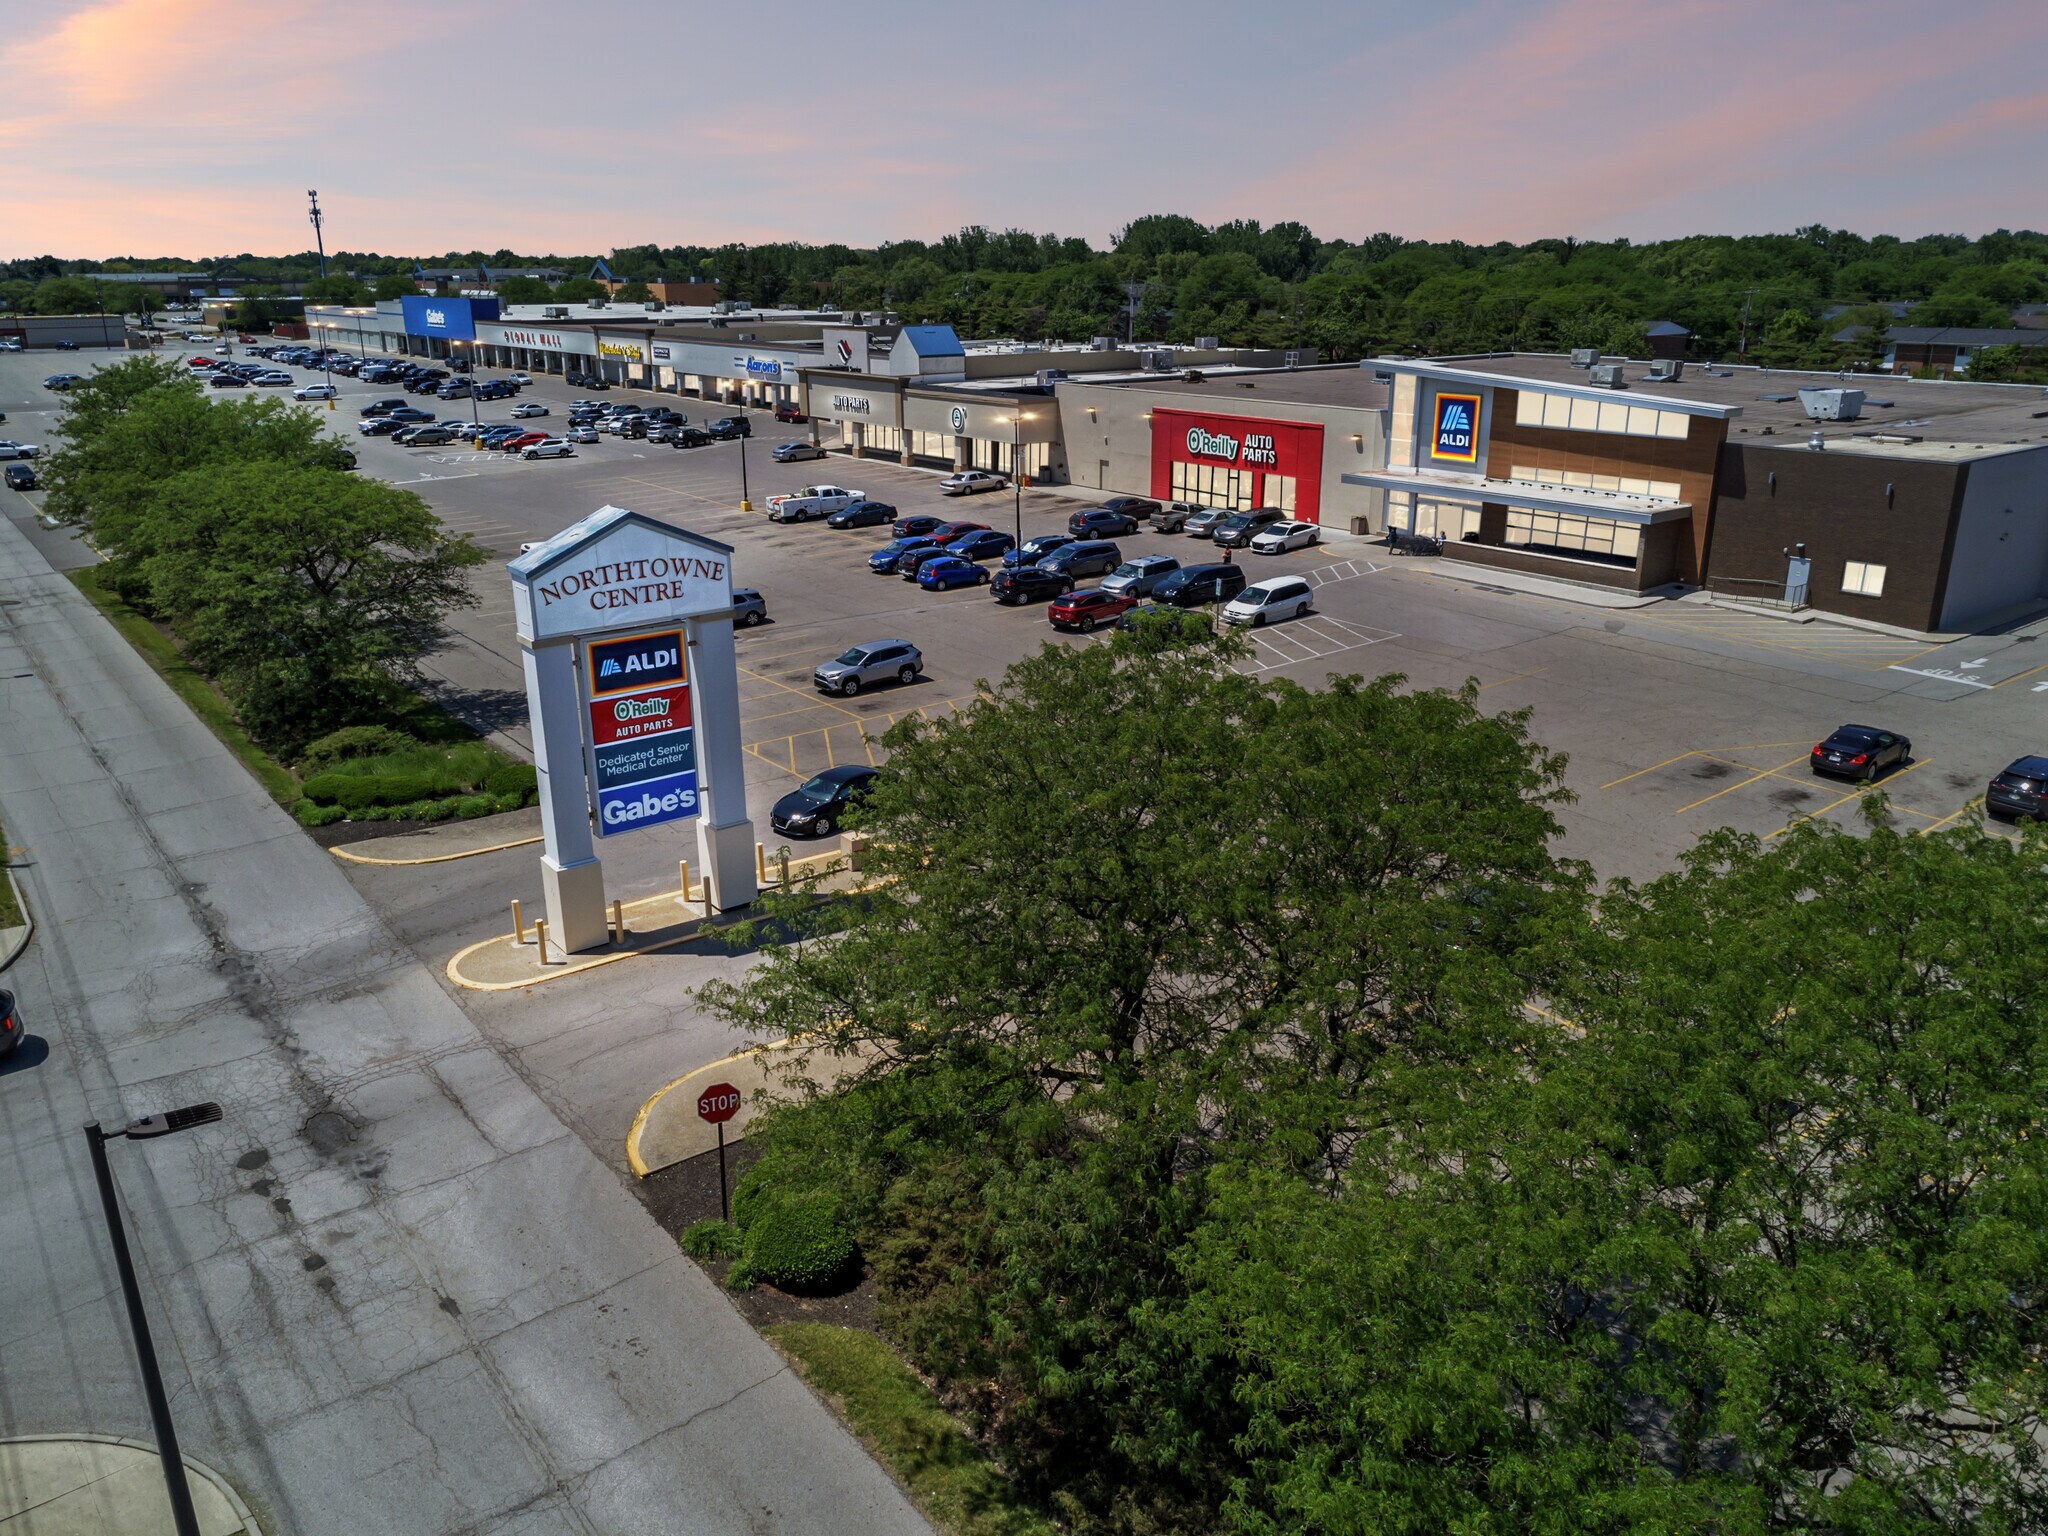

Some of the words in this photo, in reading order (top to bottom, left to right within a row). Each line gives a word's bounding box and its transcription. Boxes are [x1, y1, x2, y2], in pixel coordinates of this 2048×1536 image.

[504, 330, 536, 345] GLOBAL
[540, 333, 562, 348] MALL
[746, 355, 779, 374] Aaron's
[833, 395, 848, 407] AUTO
[849, 397, 868, 410] PARTS
[1187, 427, 1238, 460] O'Reilly
[1244, 433, 1273, 449] AUTO
[1439, 433, 1470, 447] ALDI
[1242, 447, 1276, 464] PARTS
[538, 557, 726, 607] NORTHTOWNE
[589, 580, 685, 611] CENTRE
[625, 648, 678, 673] ALDI
[1922, 668, 1981, 682] STOP
[615, 698, 669, 720] O'Reilly
[616, 724, 641, 737] AUTO
[643, 718, 673, 732] PARTS
[599, 748, 654, 768] Dedicated
[657, 743, 690, 756] Senior
[606, 760, 647, 776] Medical
[649, 754, 683, 767] Center
[603, 788, 696, 825] Gabe's
[700, 1093, 739, 1114] STOP
